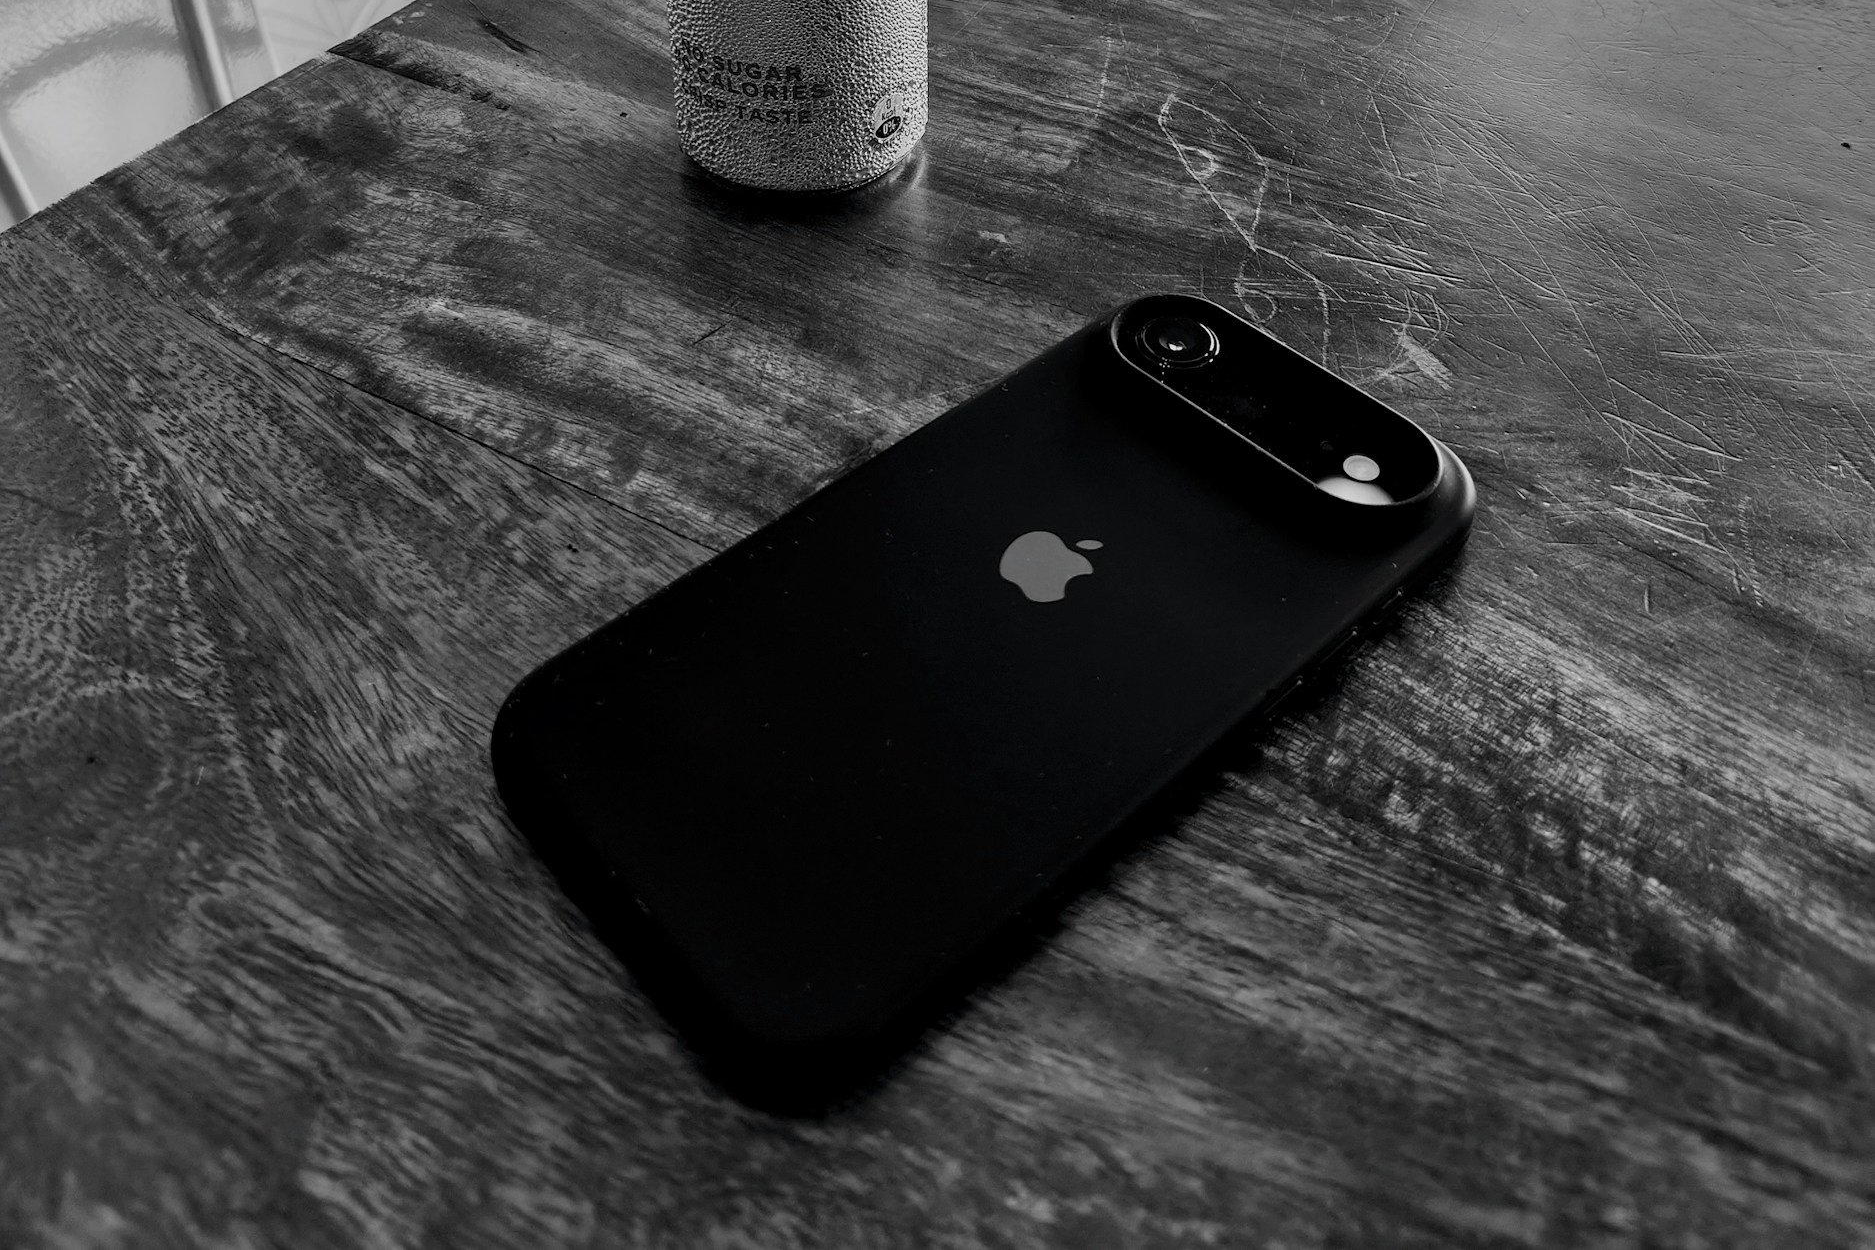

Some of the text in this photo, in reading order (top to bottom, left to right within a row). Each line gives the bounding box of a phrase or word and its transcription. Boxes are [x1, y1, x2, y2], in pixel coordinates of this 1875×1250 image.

[712, 55, 803, 82] SUGAR
[697, 67, 827, 100] CALORIES
[734, 105, 813, 124] TASTE
